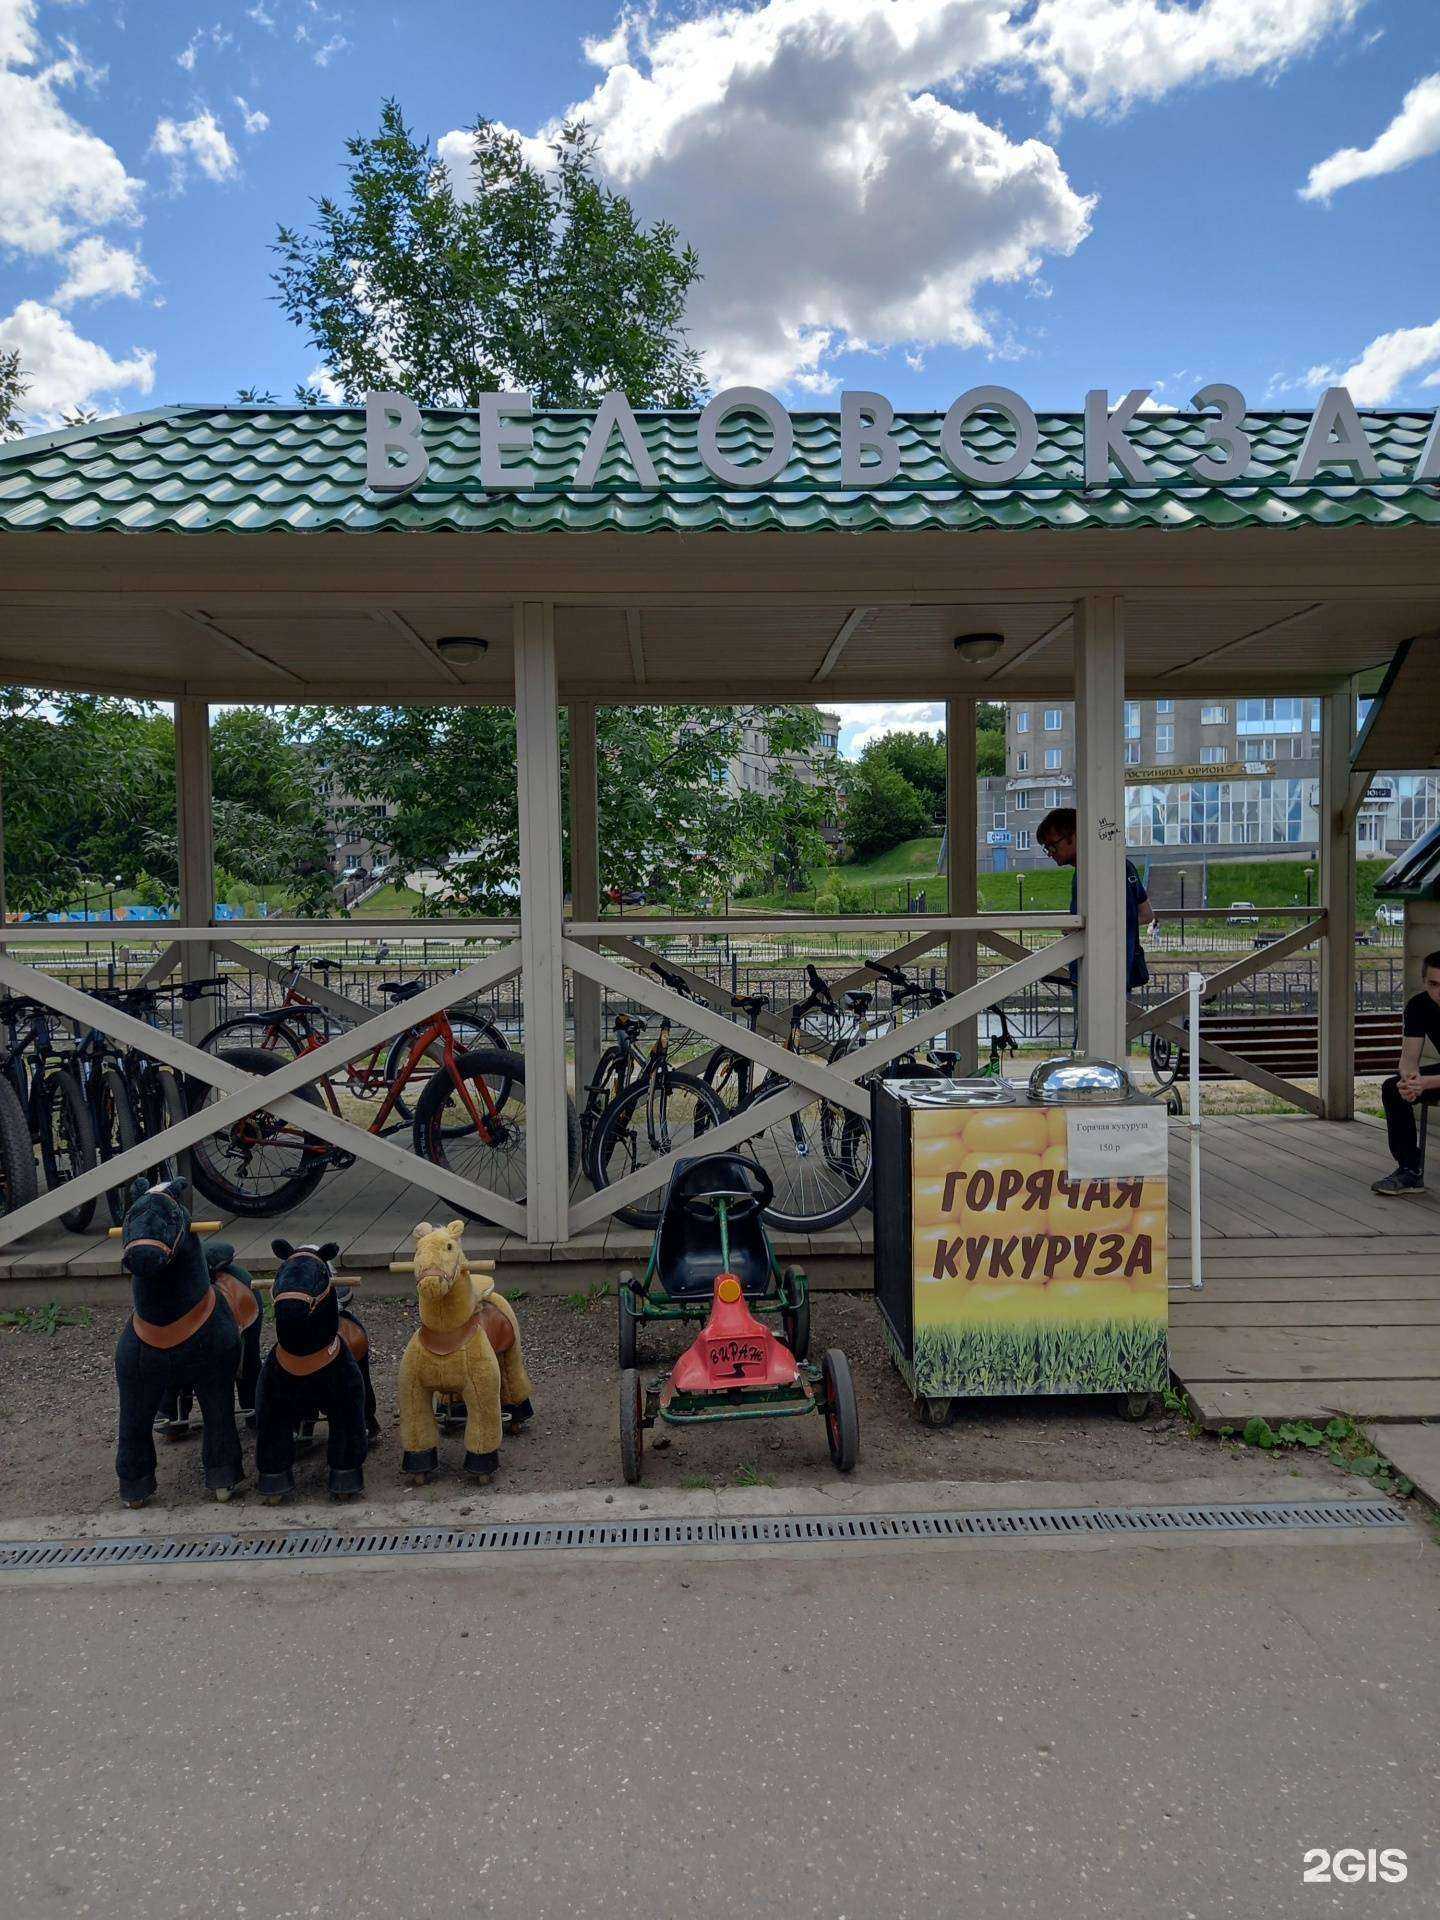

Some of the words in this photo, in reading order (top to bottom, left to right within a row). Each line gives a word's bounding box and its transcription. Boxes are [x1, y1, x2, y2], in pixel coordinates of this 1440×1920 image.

[1188, 764, 1224, 776] ОРИОН
[1077, 1123, 1110, 1134] Горячая
[1112, 1123, 1148, 1132] кукуруза
[1100, 1144, 1113, 1152] 150
[941, 1169, 1144, 1212] ГОРЯЧАЯ
[932, 1232, 1153, 1281] КУКУРУЗА
